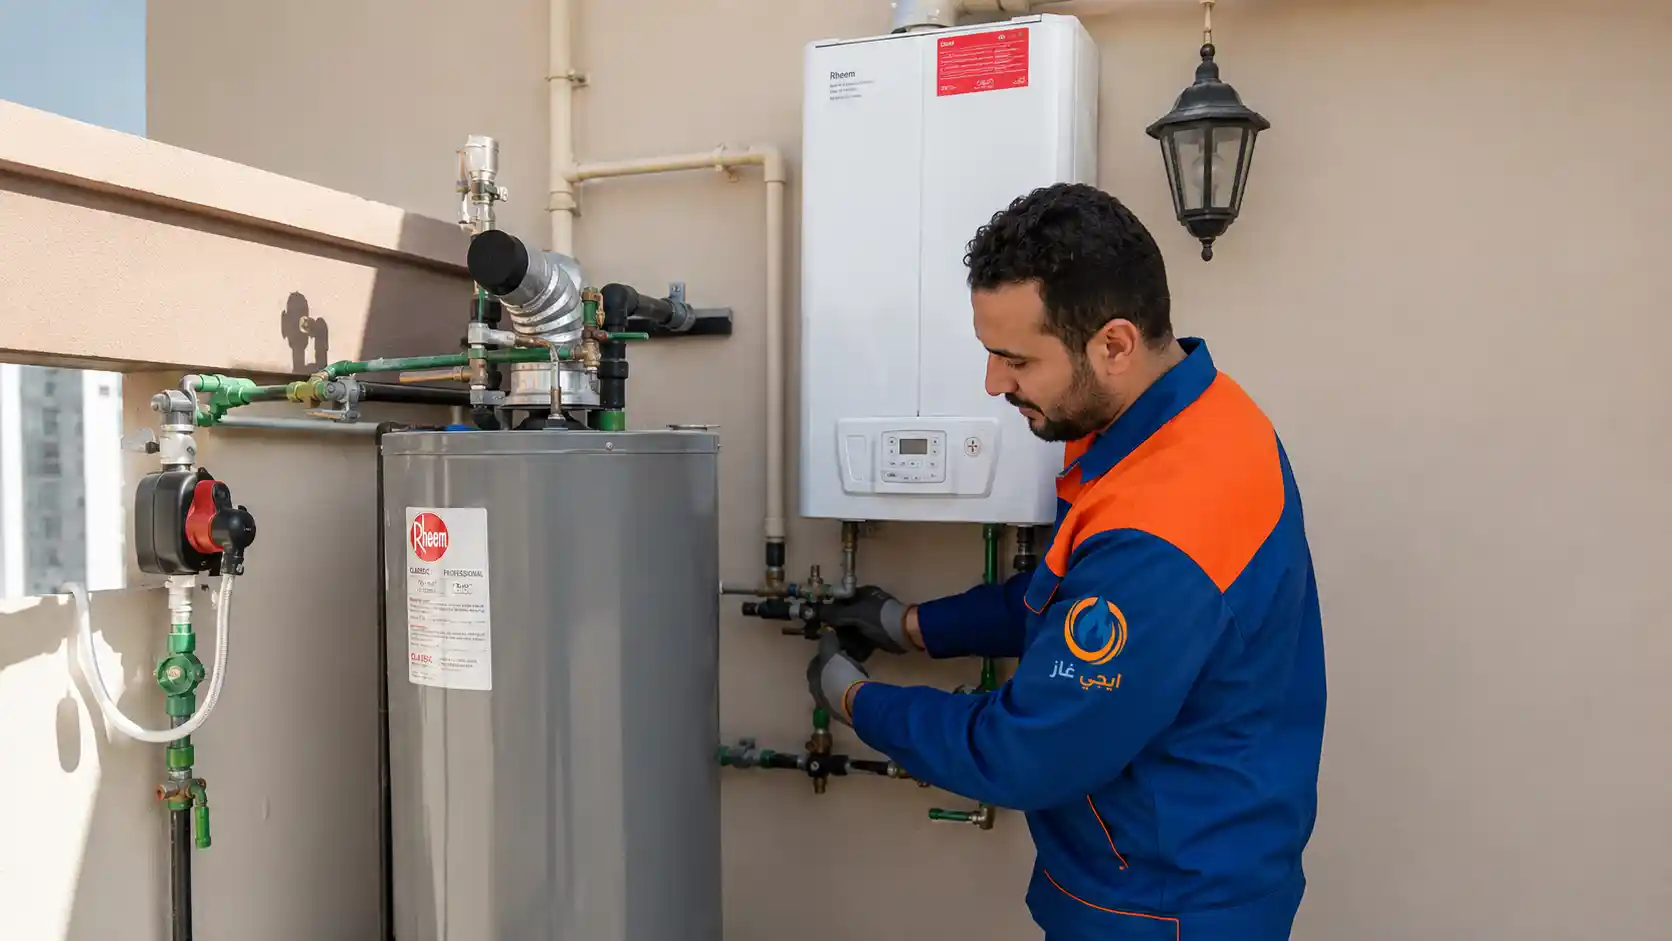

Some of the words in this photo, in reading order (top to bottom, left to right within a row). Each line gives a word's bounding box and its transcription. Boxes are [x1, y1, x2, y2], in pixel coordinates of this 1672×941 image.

[830, 71, 856, 80] Rheem
[413, 514, 447, 554] Rheem
[1049, 660, 1075, 678] غاز
[1079, 673, 1121, 692] ايجي
